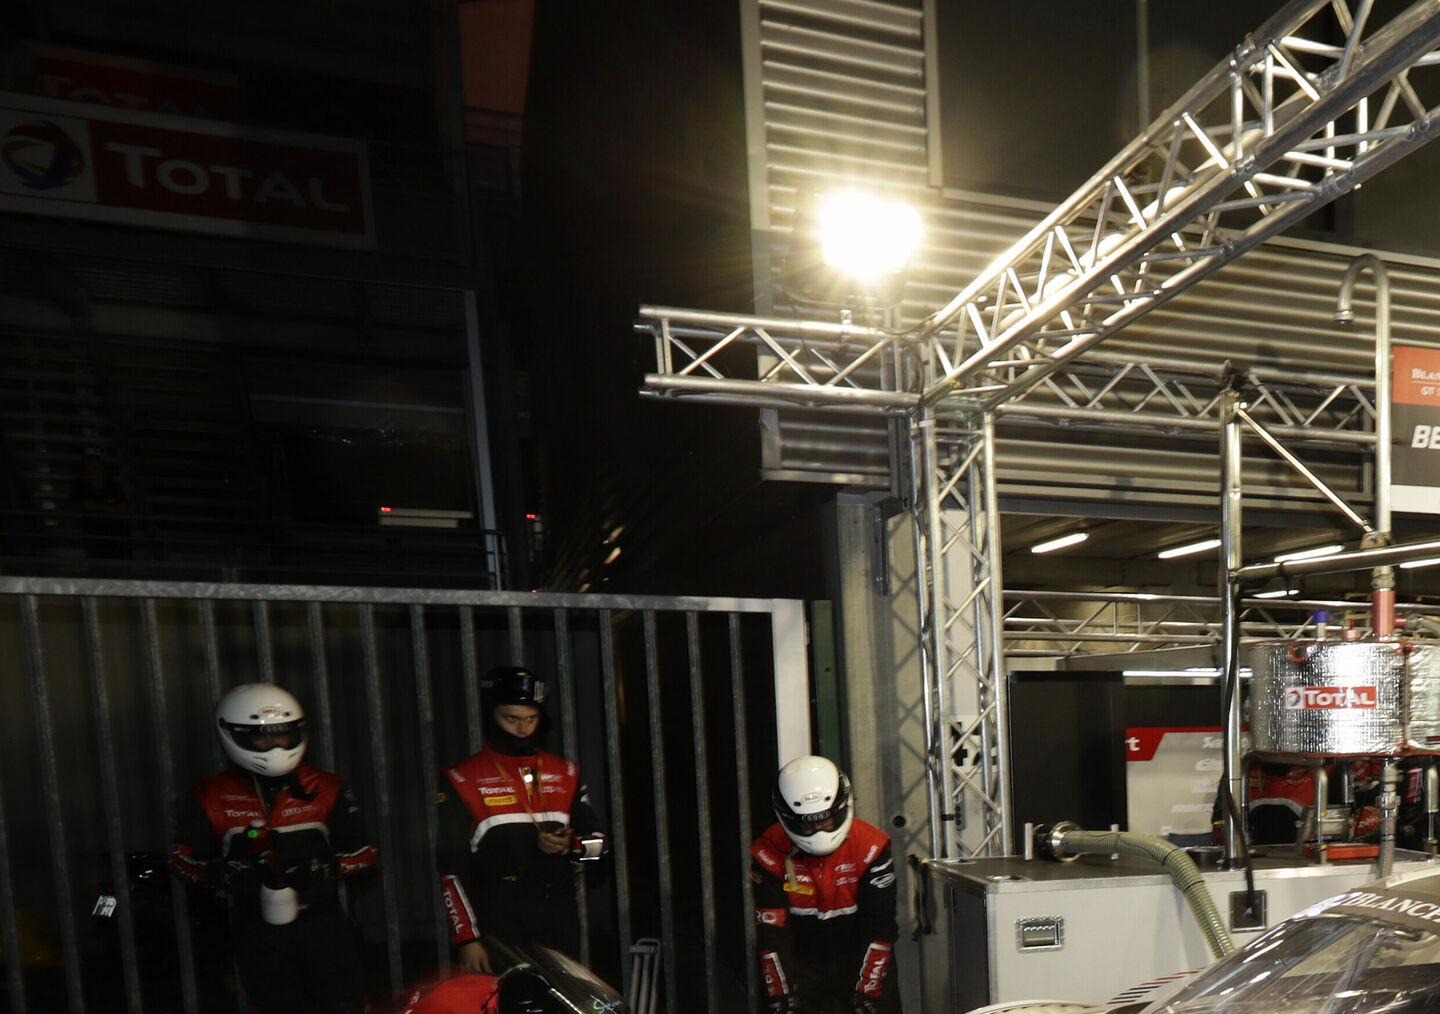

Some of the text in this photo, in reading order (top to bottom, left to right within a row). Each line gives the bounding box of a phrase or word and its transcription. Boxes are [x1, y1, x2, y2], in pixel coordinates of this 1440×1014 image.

[103, 141, 350, 214] TOTAL
[1304, 690, 1376, 706] TOTAL
[443, 889, 466, 935] TOTAL
